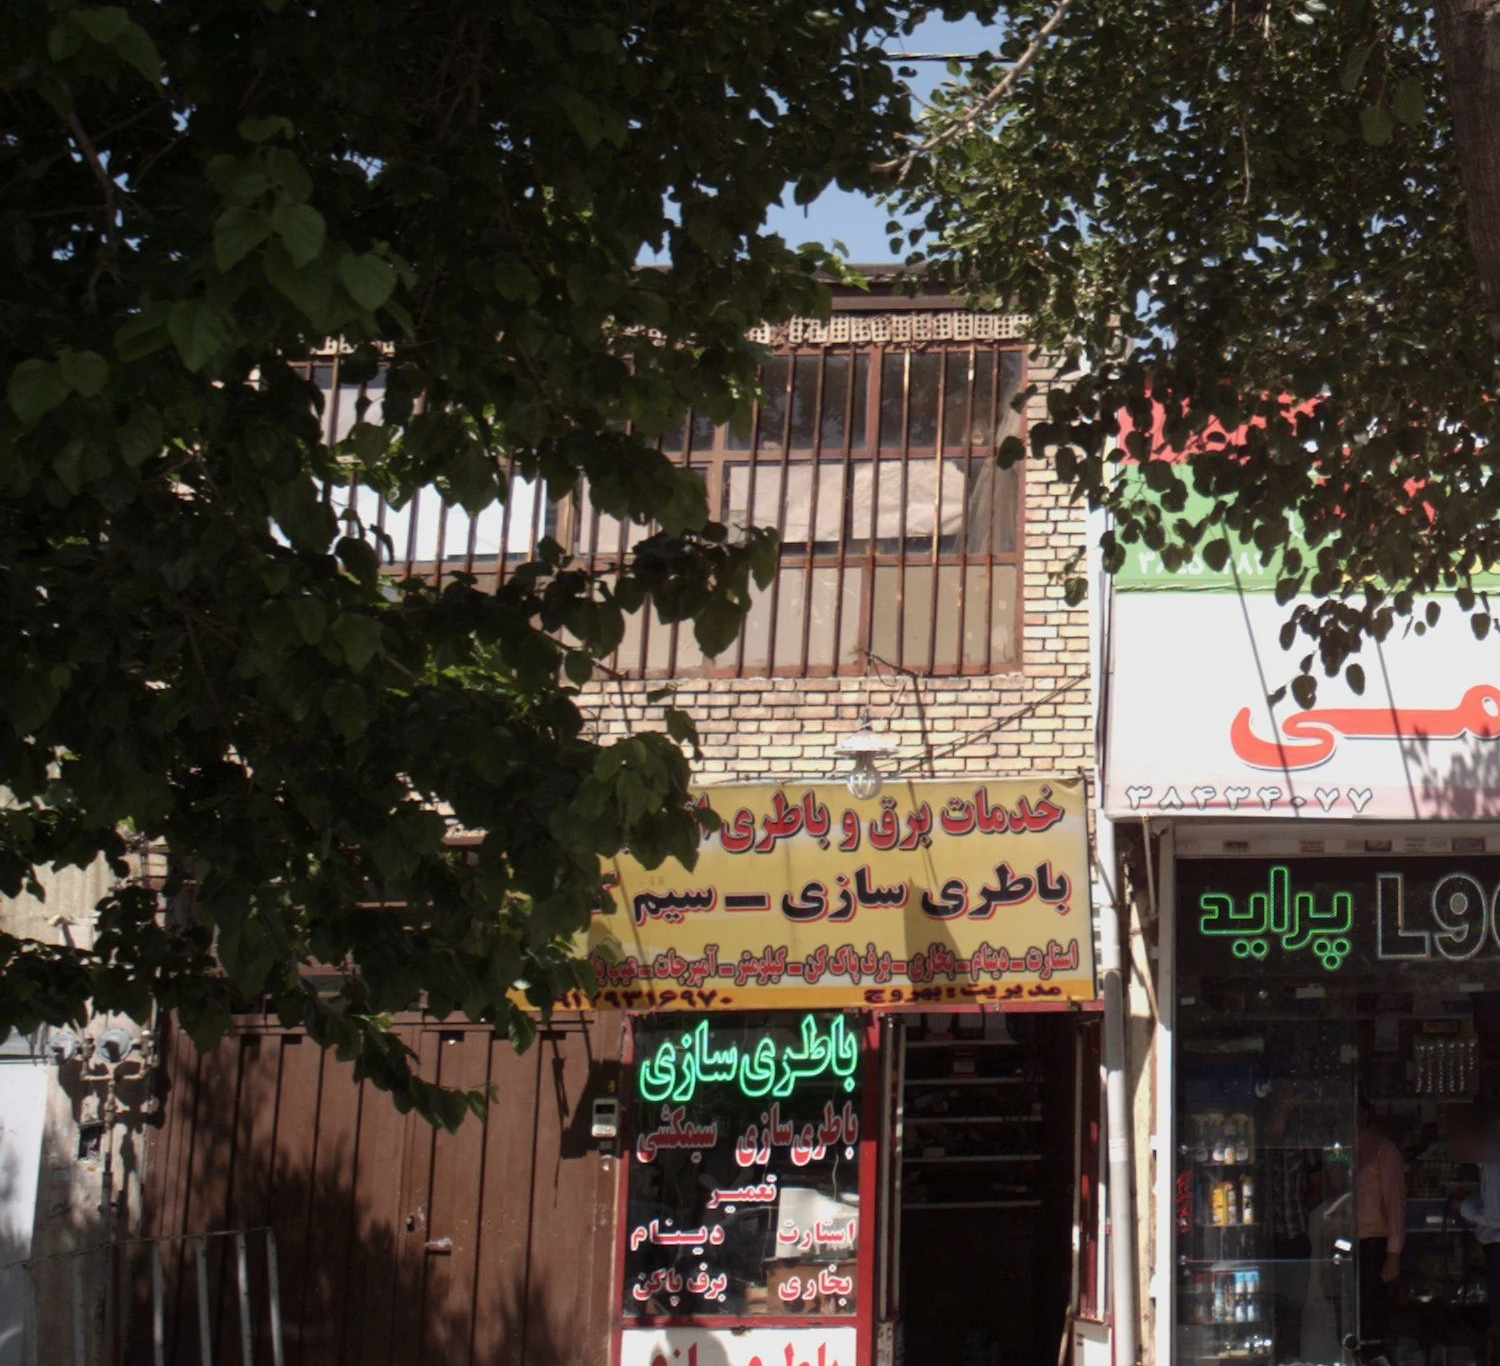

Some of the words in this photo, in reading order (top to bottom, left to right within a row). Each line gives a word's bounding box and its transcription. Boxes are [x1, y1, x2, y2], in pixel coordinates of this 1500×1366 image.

[719, 789, 831, 854] باطری
[867, 795, 933, 851] برق
[939, 784, 1065, 836] خدمات
[1123, 784, 1374, 813] ۳۸۴۳۴۰۷۷
[836, 805, 861, 851] و
[631, 884, 717, 926] سیم
[779, 863, 909, 922] سازی
[920, 859, 1073, 919] باطری
[1199, 864, 1353, 971] پراید
[907, 942, 955, 982] بخاری
[970, 940, 1009, 982] دینام
[1026, 937, 1079, 980] استارت
[639, 1018, 738, 1102] سازی
[739, 1013, 858, 1099] باطری
[636, 1103, 718, 1164] سیمکشی
[734, 1101, 793, 1168] سازی
[790, 1099, 859, 1167] باطری
[706, 1173, 778, 1214] تعمیر
[629, 1217, 726, 1255] دینام
[776, 1218, 858, 1251] استارت
[686, 1261, 729, 1303] برف
[777, 1263, 854, 1308] بخاری
